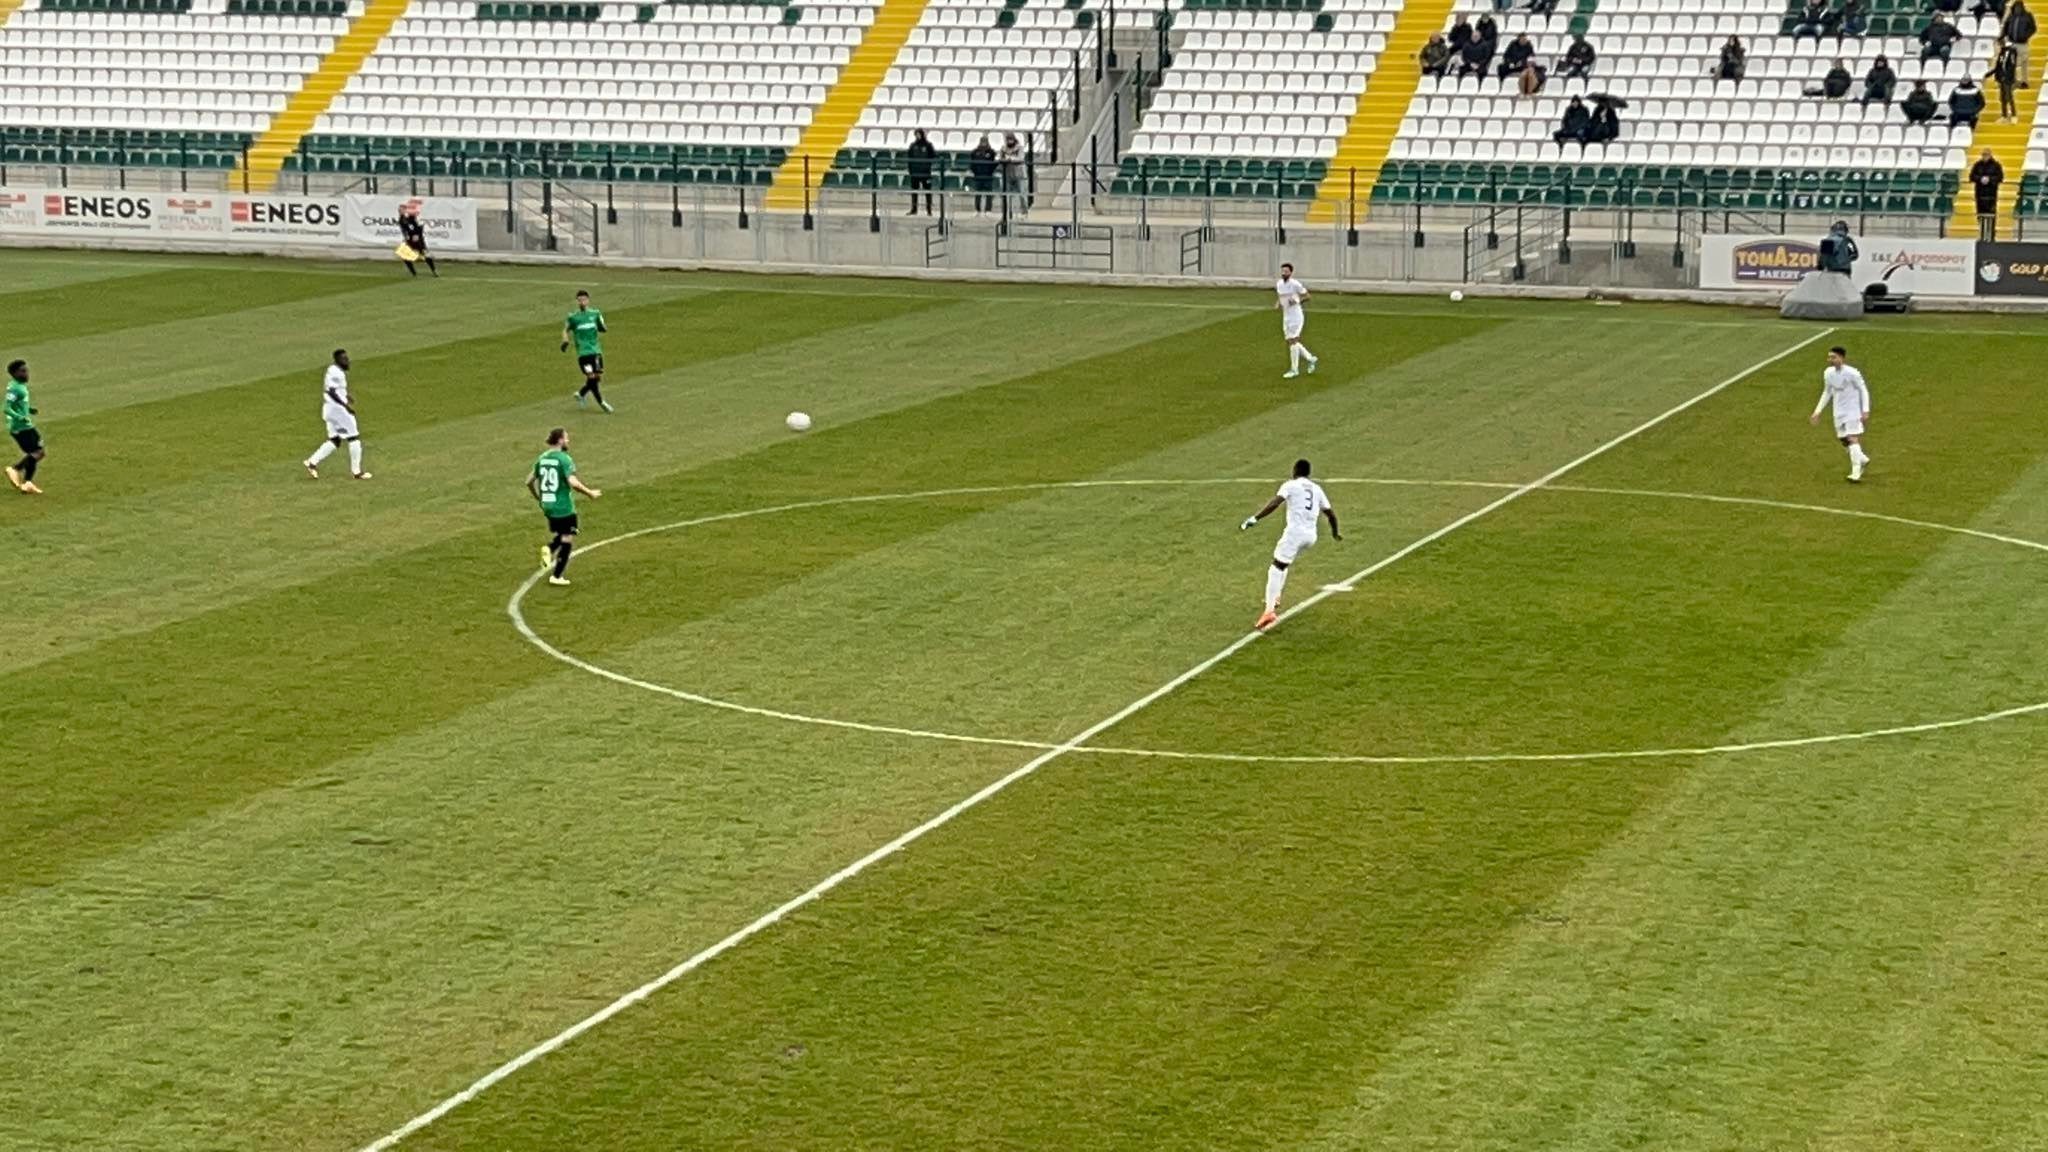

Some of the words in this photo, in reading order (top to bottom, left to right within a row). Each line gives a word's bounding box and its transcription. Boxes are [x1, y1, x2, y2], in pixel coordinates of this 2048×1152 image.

[64, 196, 151, 219] ENEOS
[251, 202, 340, 226] ENEOS
[1758, 269, 1800, 280] BAKERY
[2009, 263, 2040, 275] GOLD
[540, 467, 559, 492] 29
[1304, 489, 1313, 511] 3
